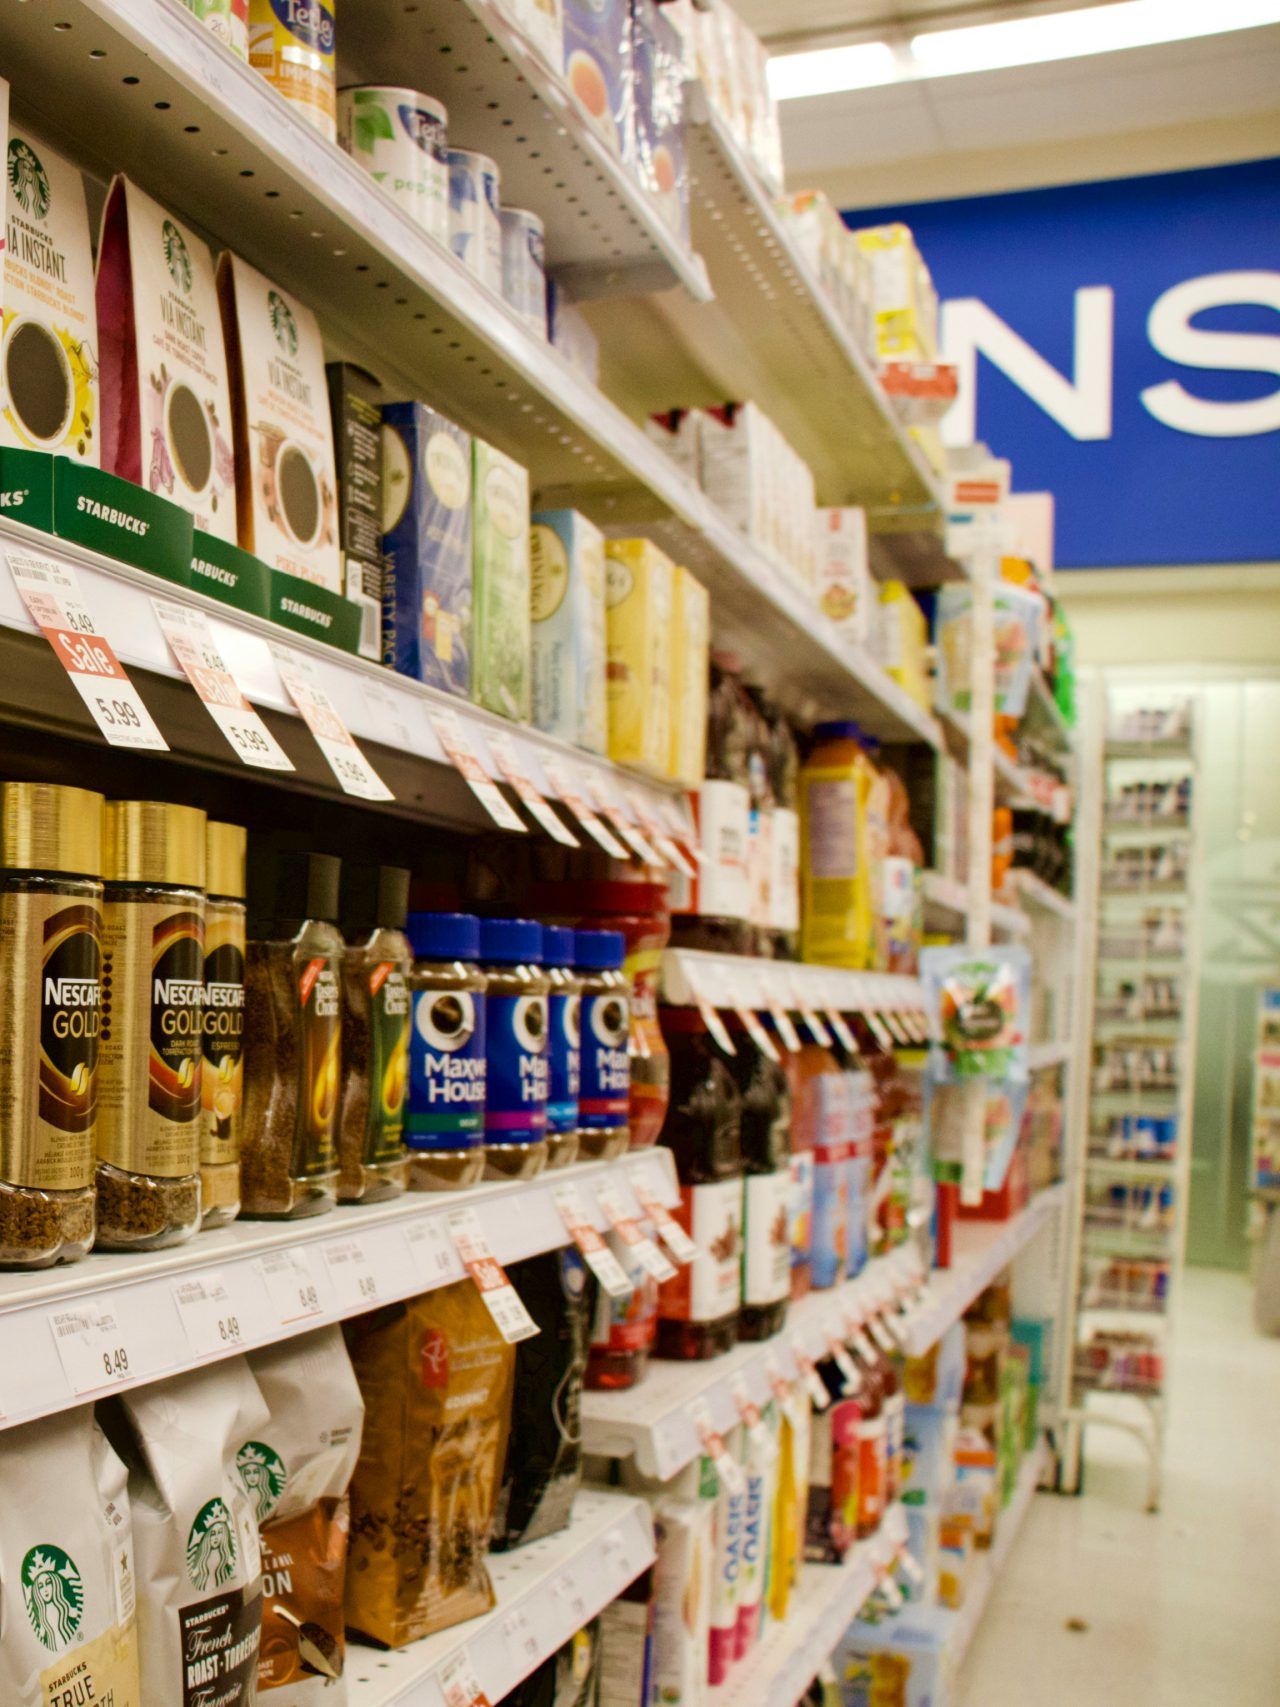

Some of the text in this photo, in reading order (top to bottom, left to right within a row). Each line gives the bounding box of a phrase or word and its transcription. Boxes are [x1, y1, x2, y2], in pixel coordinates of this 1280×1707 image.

[11, 214, 54, 247] STARBUCKS
[21, 230, 66, 284] INSTANT
[938, 270, 1280, 448] NS
[0, 490, 25, 508] KS
[76, 495, 150, 538] STARBUCKS
[190, 556, 239, 589] ARBUCKS
[382, 552, 397, 622] VARIETY
[66, 611, 95, 634] 8.49
[280, 597, 333, 630] STARBUCKS
[58, 632, 115, 676] Sale
[95, 697, 141, 728] 5.99
[229, 725, 270, 753] 5.99
[52, 1010, 100, 1039] GOLD
[161, 1009, 203, 1035] GOLD
[203, 1010, 244, 1035] GOLD
[218, 1316, 240, 1341] 8.49
[103, 1347, 130, 1376] 8.49
[261, 1569, 294, 1599] ON
[184, 1604, 228, 1629] STARBUCKS
[185, 1622, 232, 1662] French
[48, 1660, 88, 1693] STARBUCKS
[187, 1654, 219, 1690] ROAST
[49, 1674, 96, 1707] TRUE
